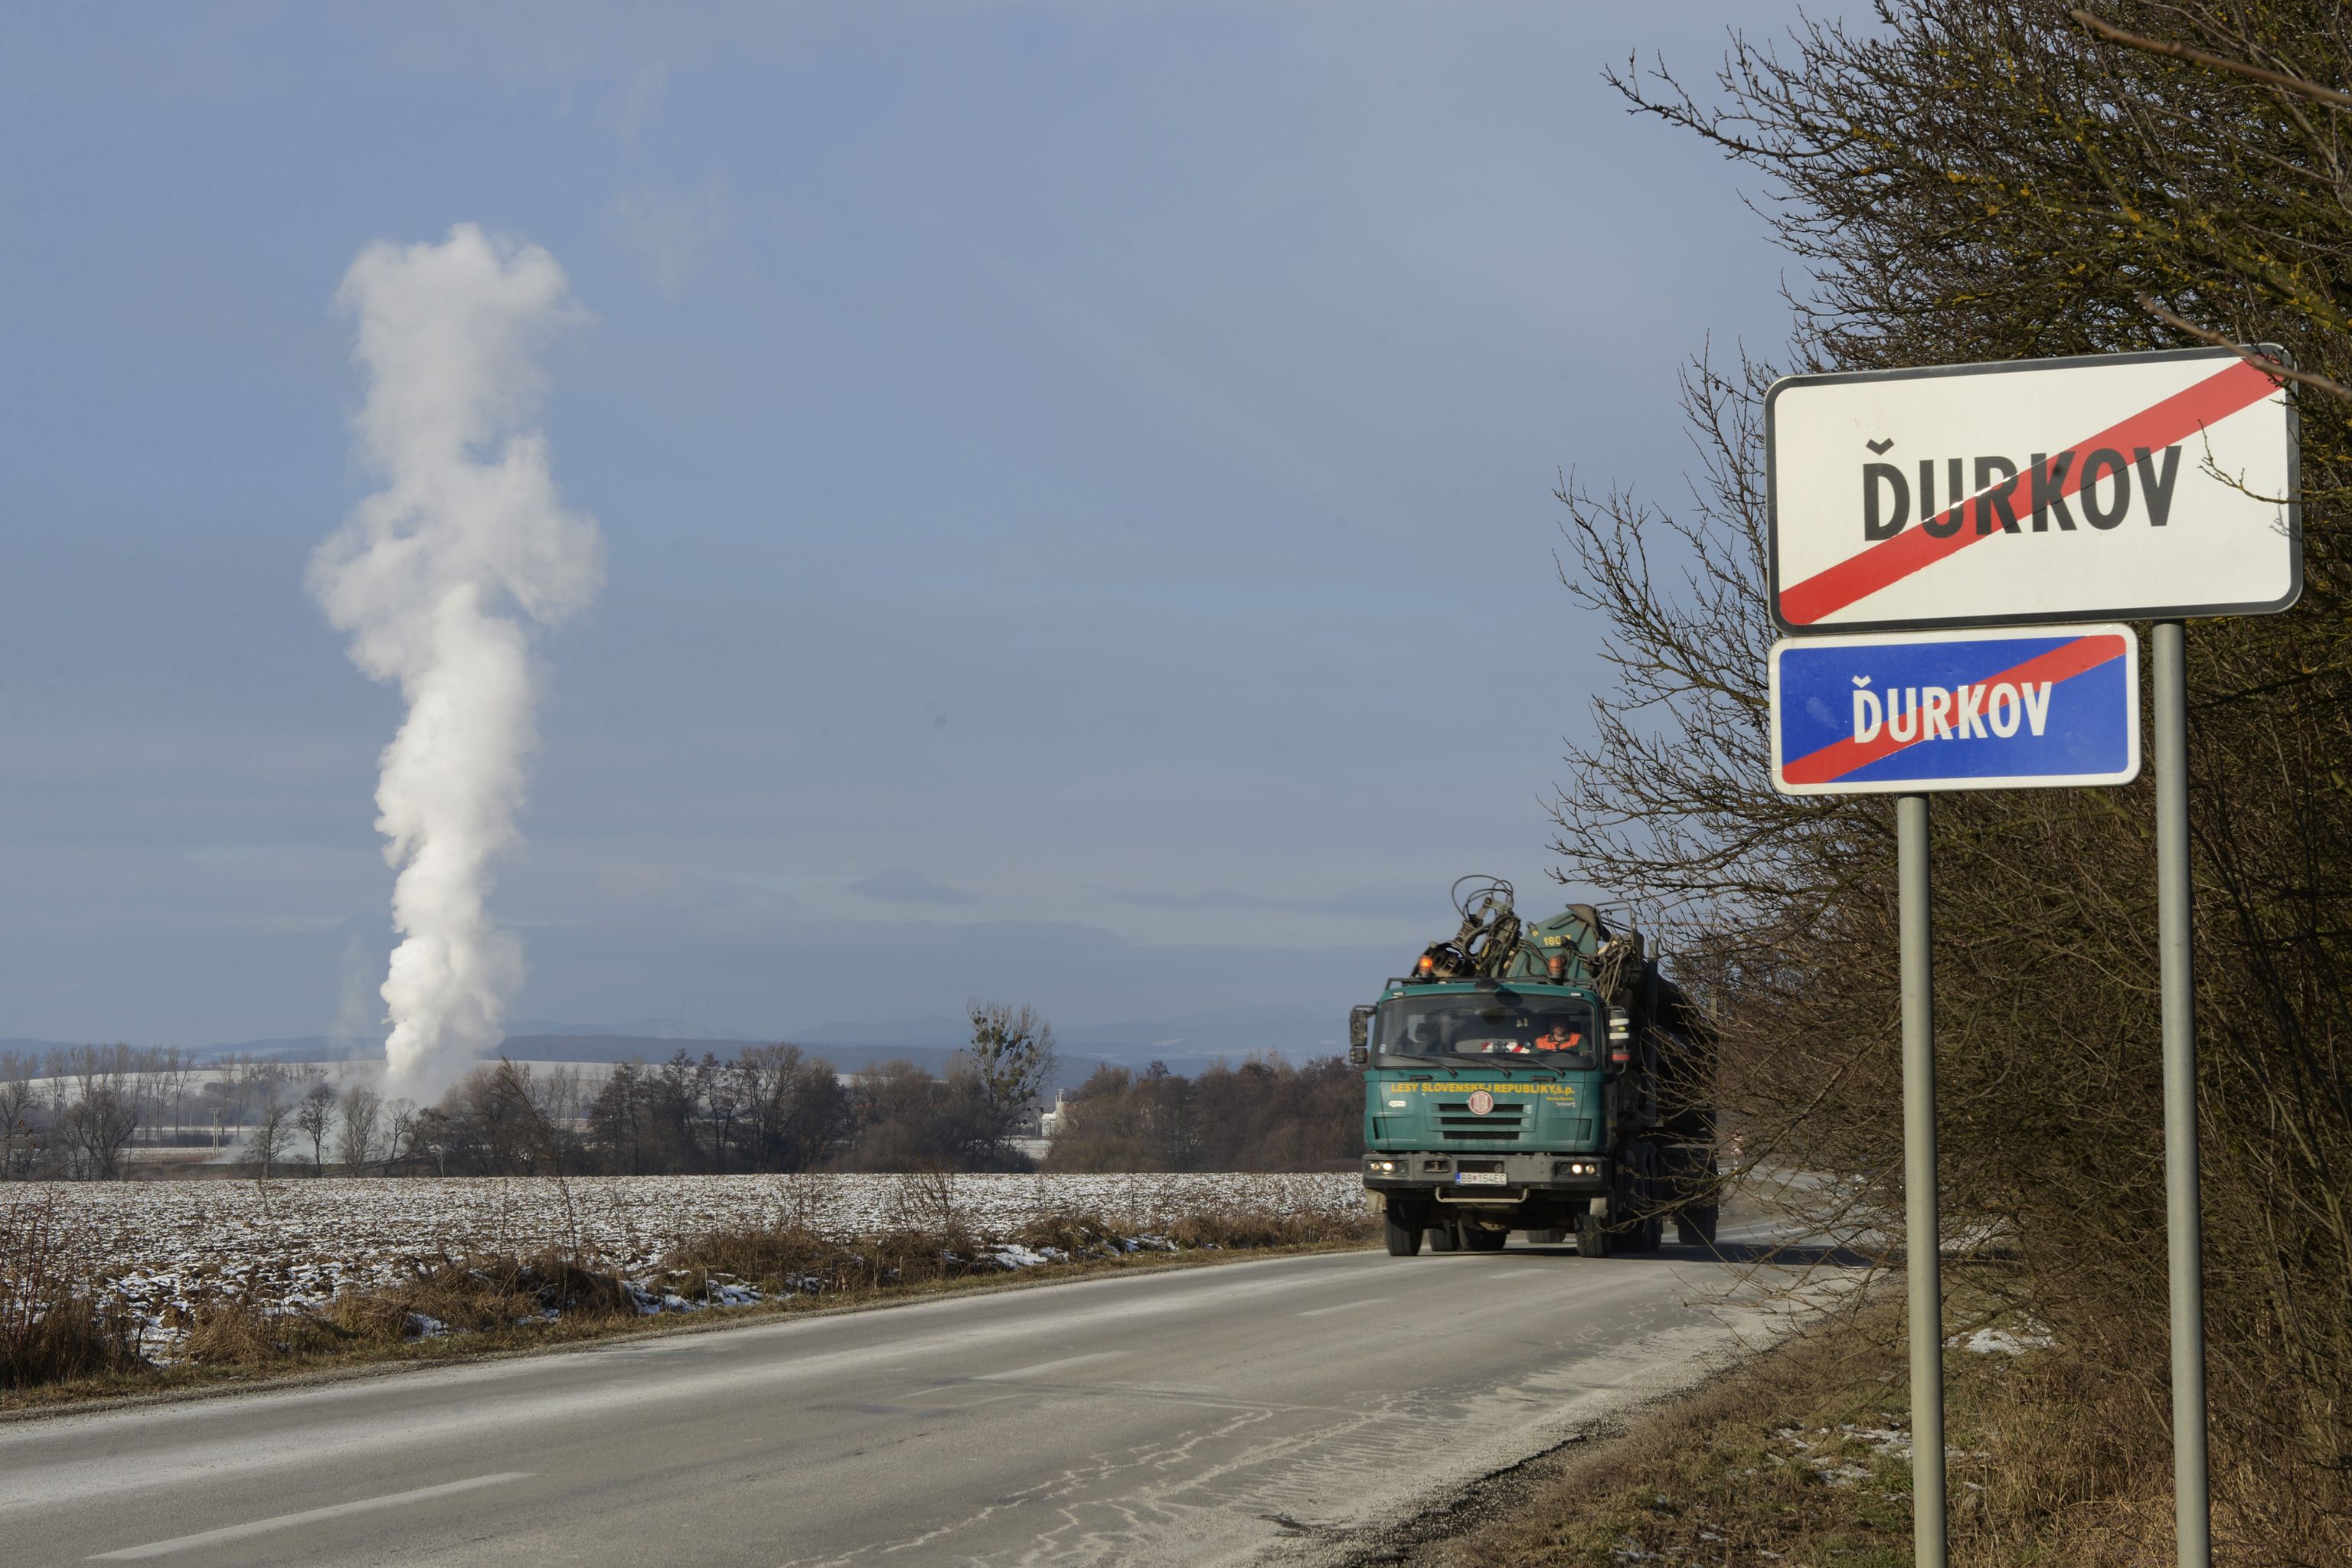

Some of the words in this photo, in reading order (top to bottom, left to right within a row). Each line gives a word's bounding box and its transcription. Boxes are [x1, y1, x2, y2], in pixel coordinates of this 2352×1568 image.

[1862, 437, 2183, 542] ĎURKOV
[1851, 675, 2053, 744] ĎURKOV
[1390, 1083, 1419, 1093] LESY
[1420, 1083, 1492, 1093] SLOVENSKEJ
